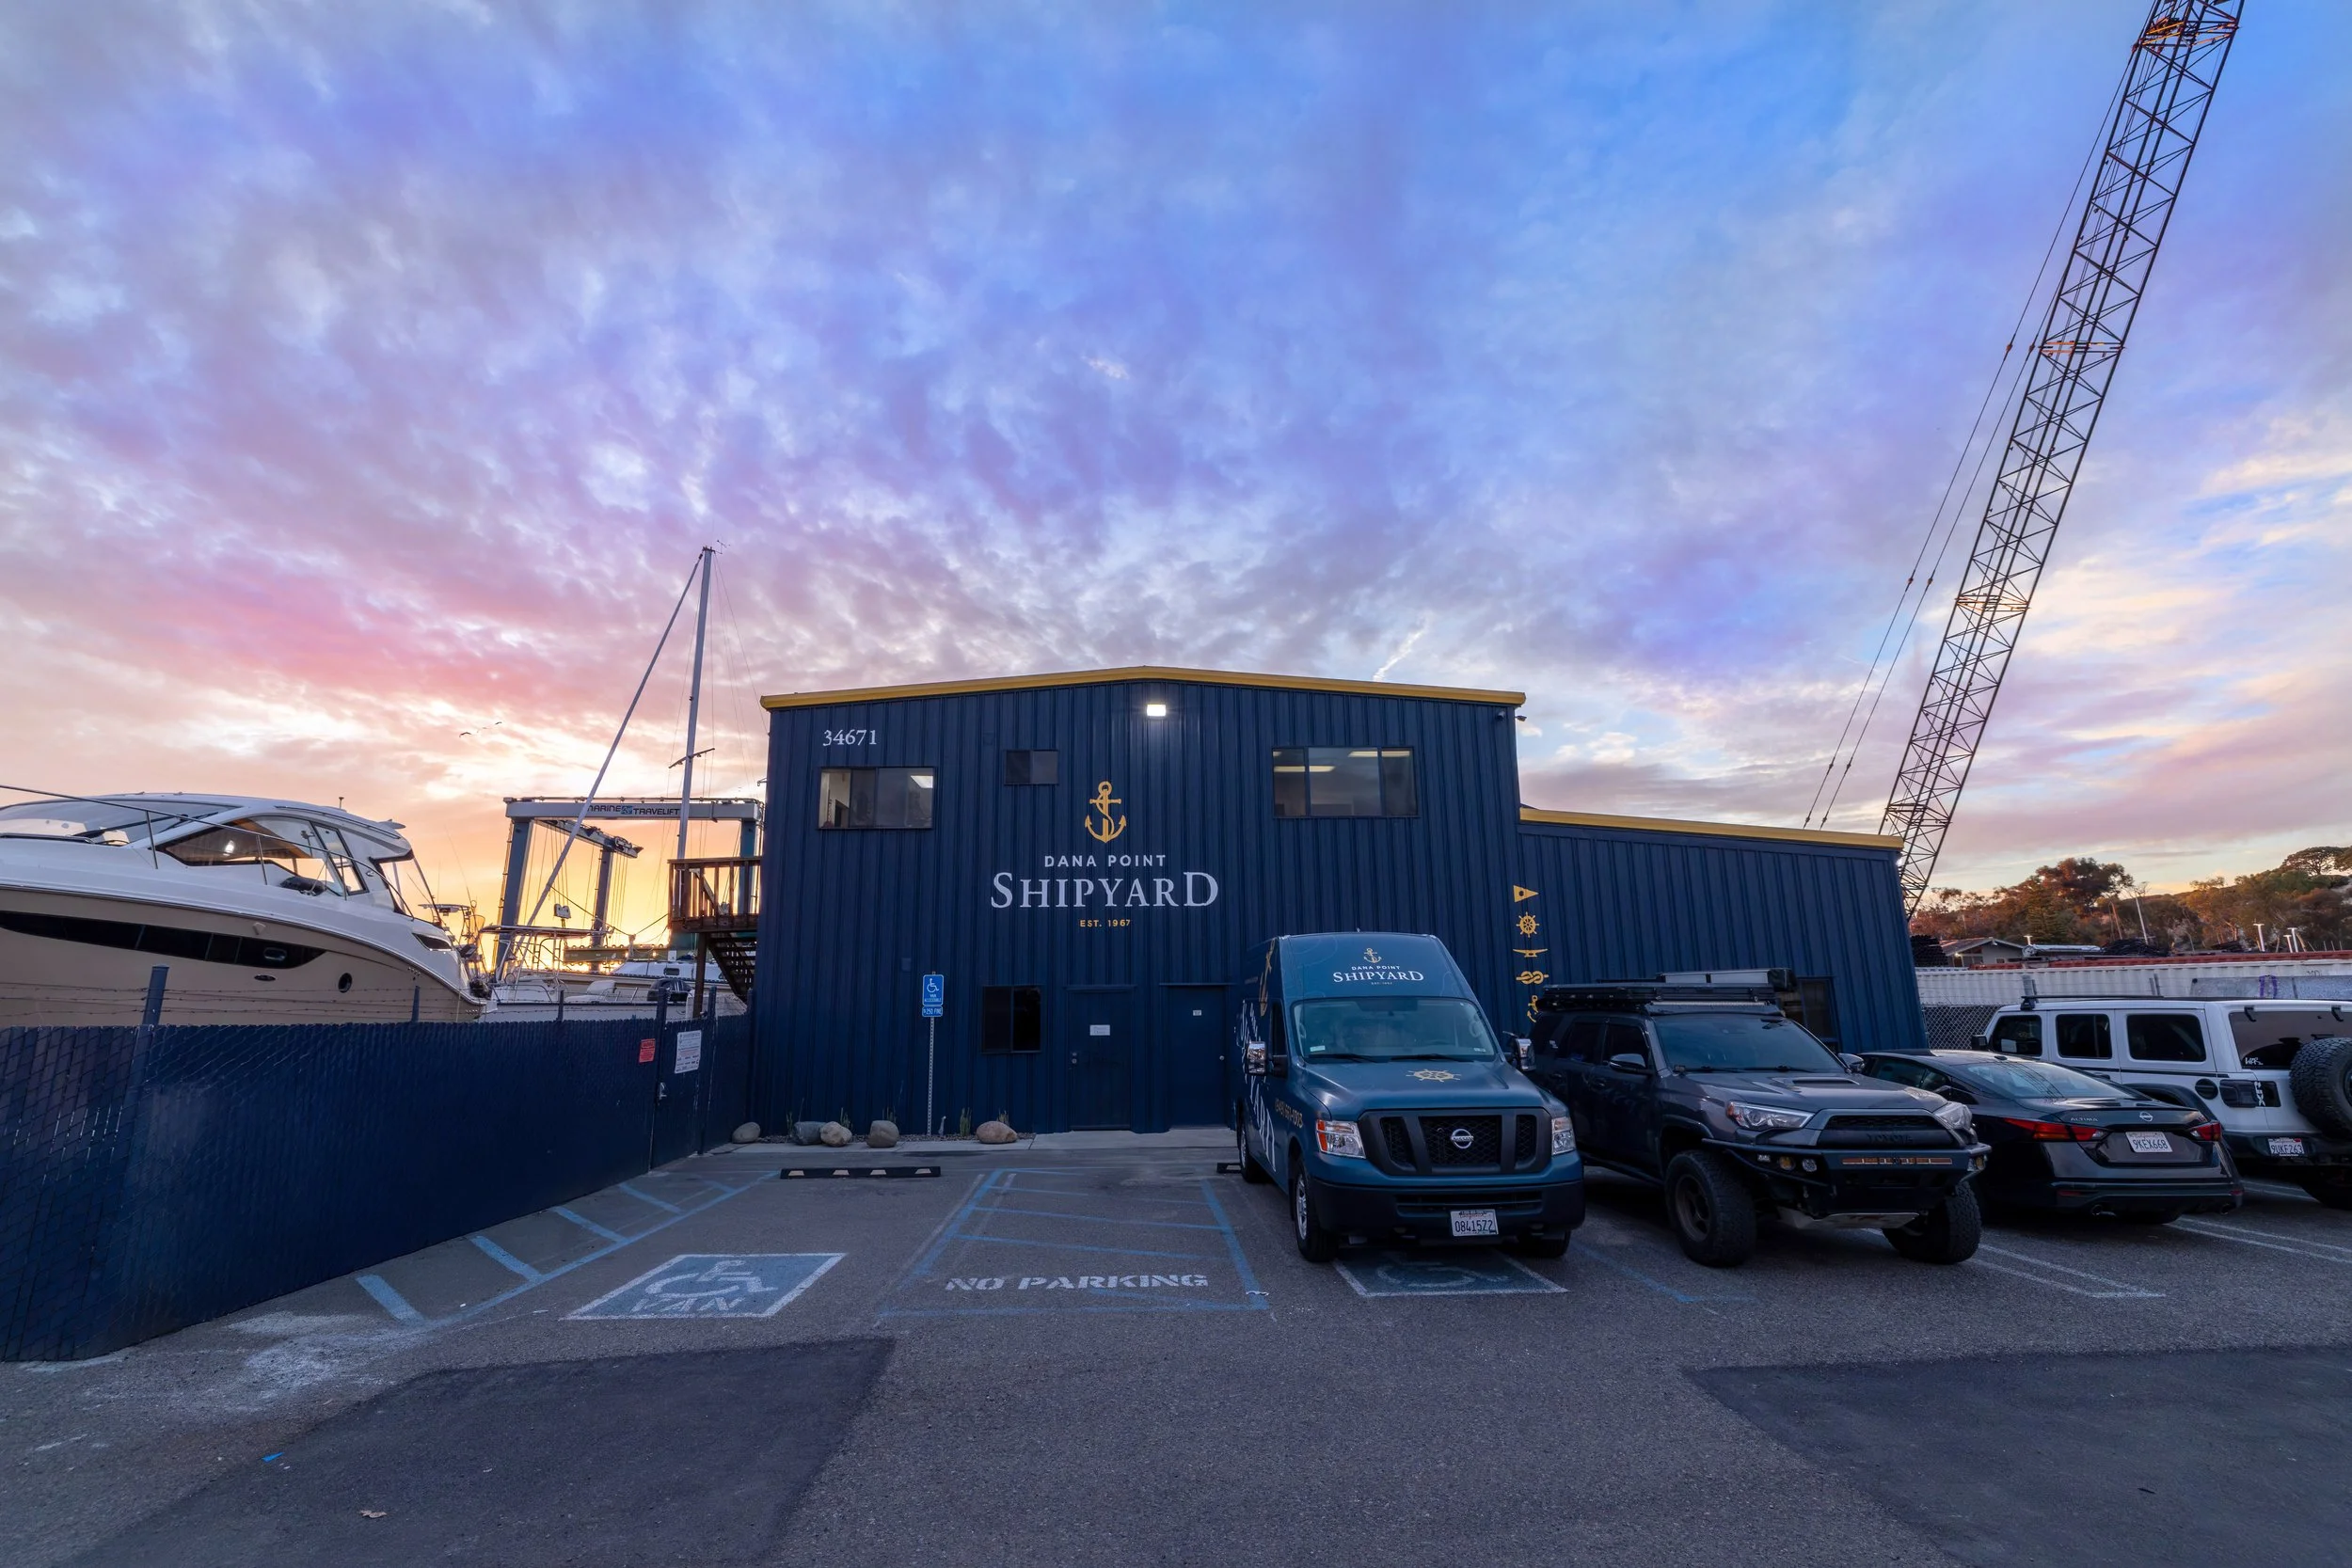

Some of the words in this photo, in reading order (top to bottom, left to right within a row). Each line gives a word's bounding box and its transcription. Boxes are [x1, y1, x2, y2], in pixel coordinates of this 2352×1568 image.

[822, 729, 877, 746] 34671
[1044, 855, 1097, 867] DANA
[1107, 854, 1166, 867] POINT
[991, 872, 1218, 909] SHIPYARD
[1079, 919, 1103, 927] EST.
[1107, 919, 1131, 927] 1967
[1332, 970, 1424, 982] SHIPYARD
[2132, 1139, 2169, 1149] 9KEX668
[945, 1277, 1006, 1291] NO
[1018, 1274, 1209, 1290] PARKING
